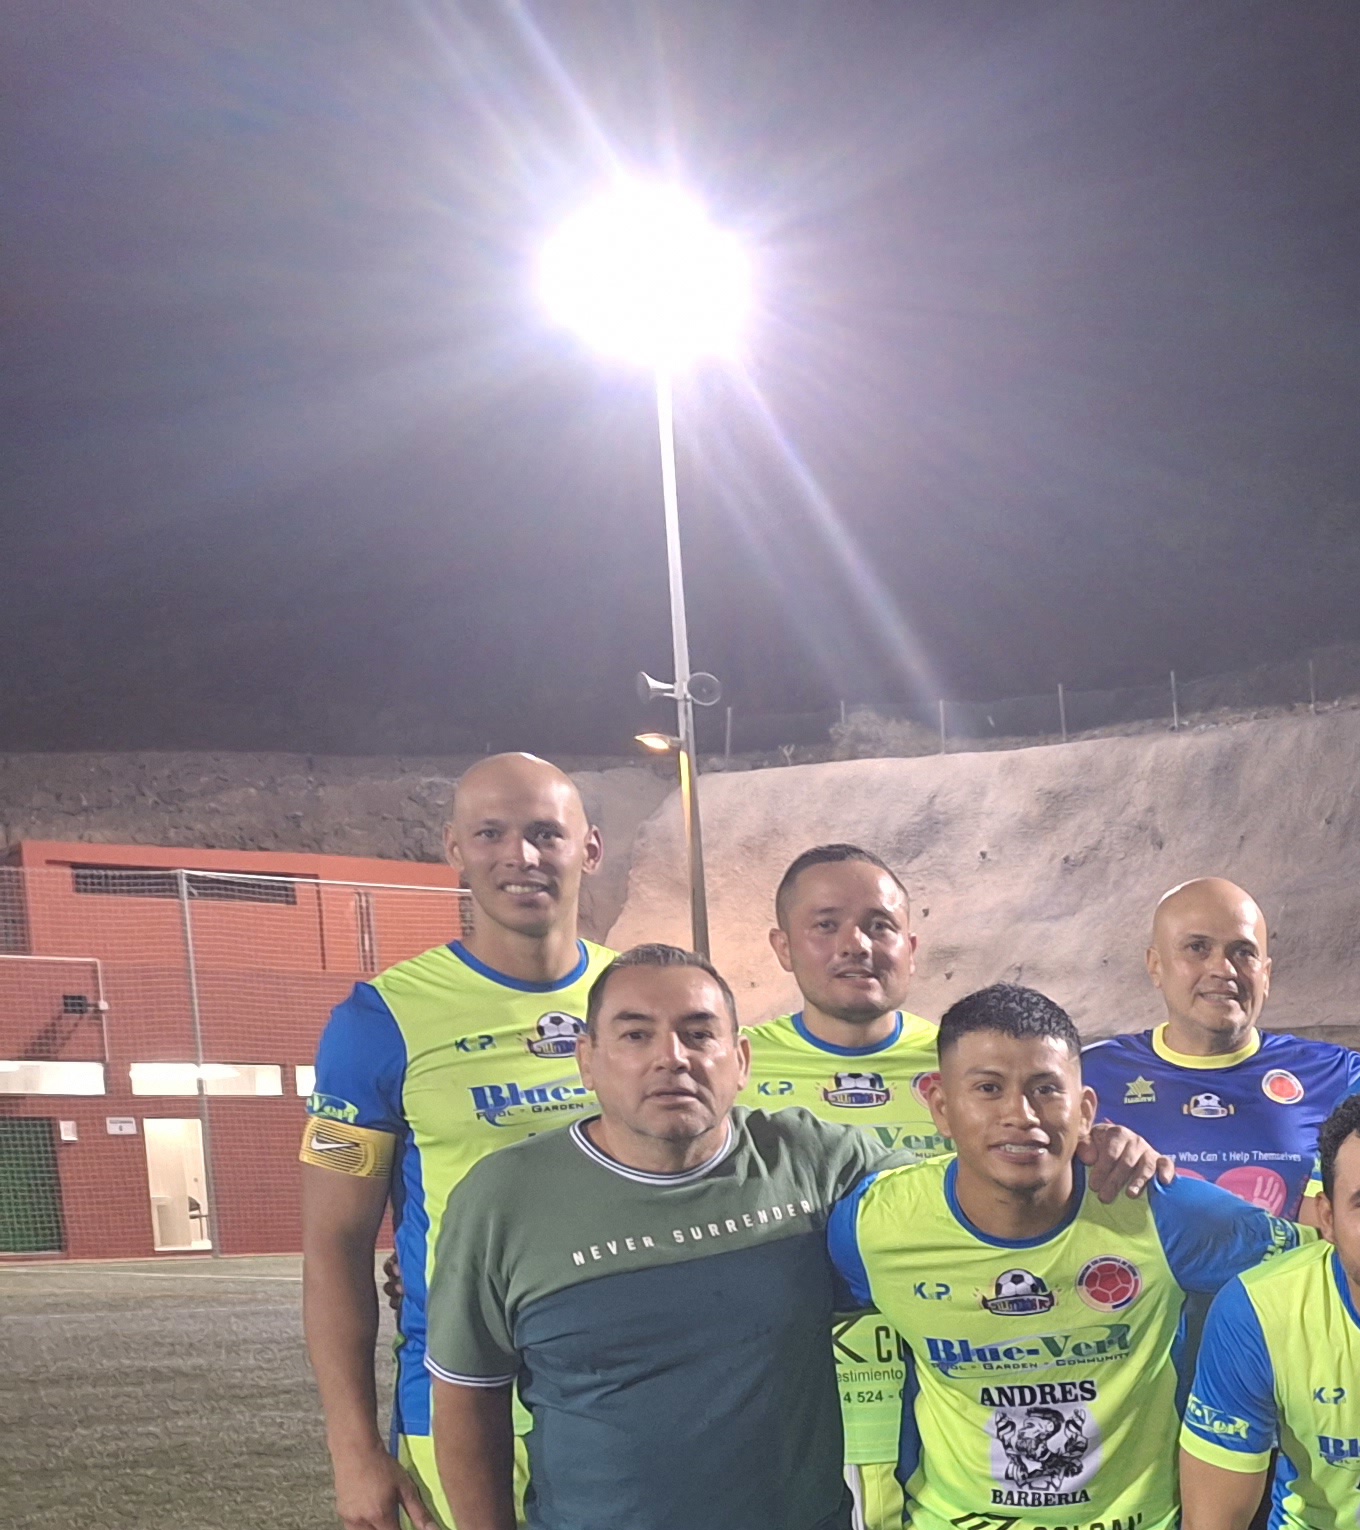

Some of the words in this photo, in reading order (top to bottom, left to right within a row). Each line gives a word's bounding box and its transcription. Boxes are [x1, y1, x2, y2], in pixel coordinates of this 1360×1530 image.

[468, 1083, 588, 1111] Blue-
[1179, 1151, 1198, 1162] Who
[1229, 1151, 1249, 1163] Help
[1252, 1150, 1301, 1162] Themselves
[573, 1235, 654, 1266] NEVER
[673, 1199, 812, 1243] SURRENDER
[925, 1324, 1131, 1363] Blue-Vert
[857, 1390, 883, 1403] 524
[980, 1380, 1097, 1407] ANDRES
[991, 1489, 1091, 1507] BARBERIA
